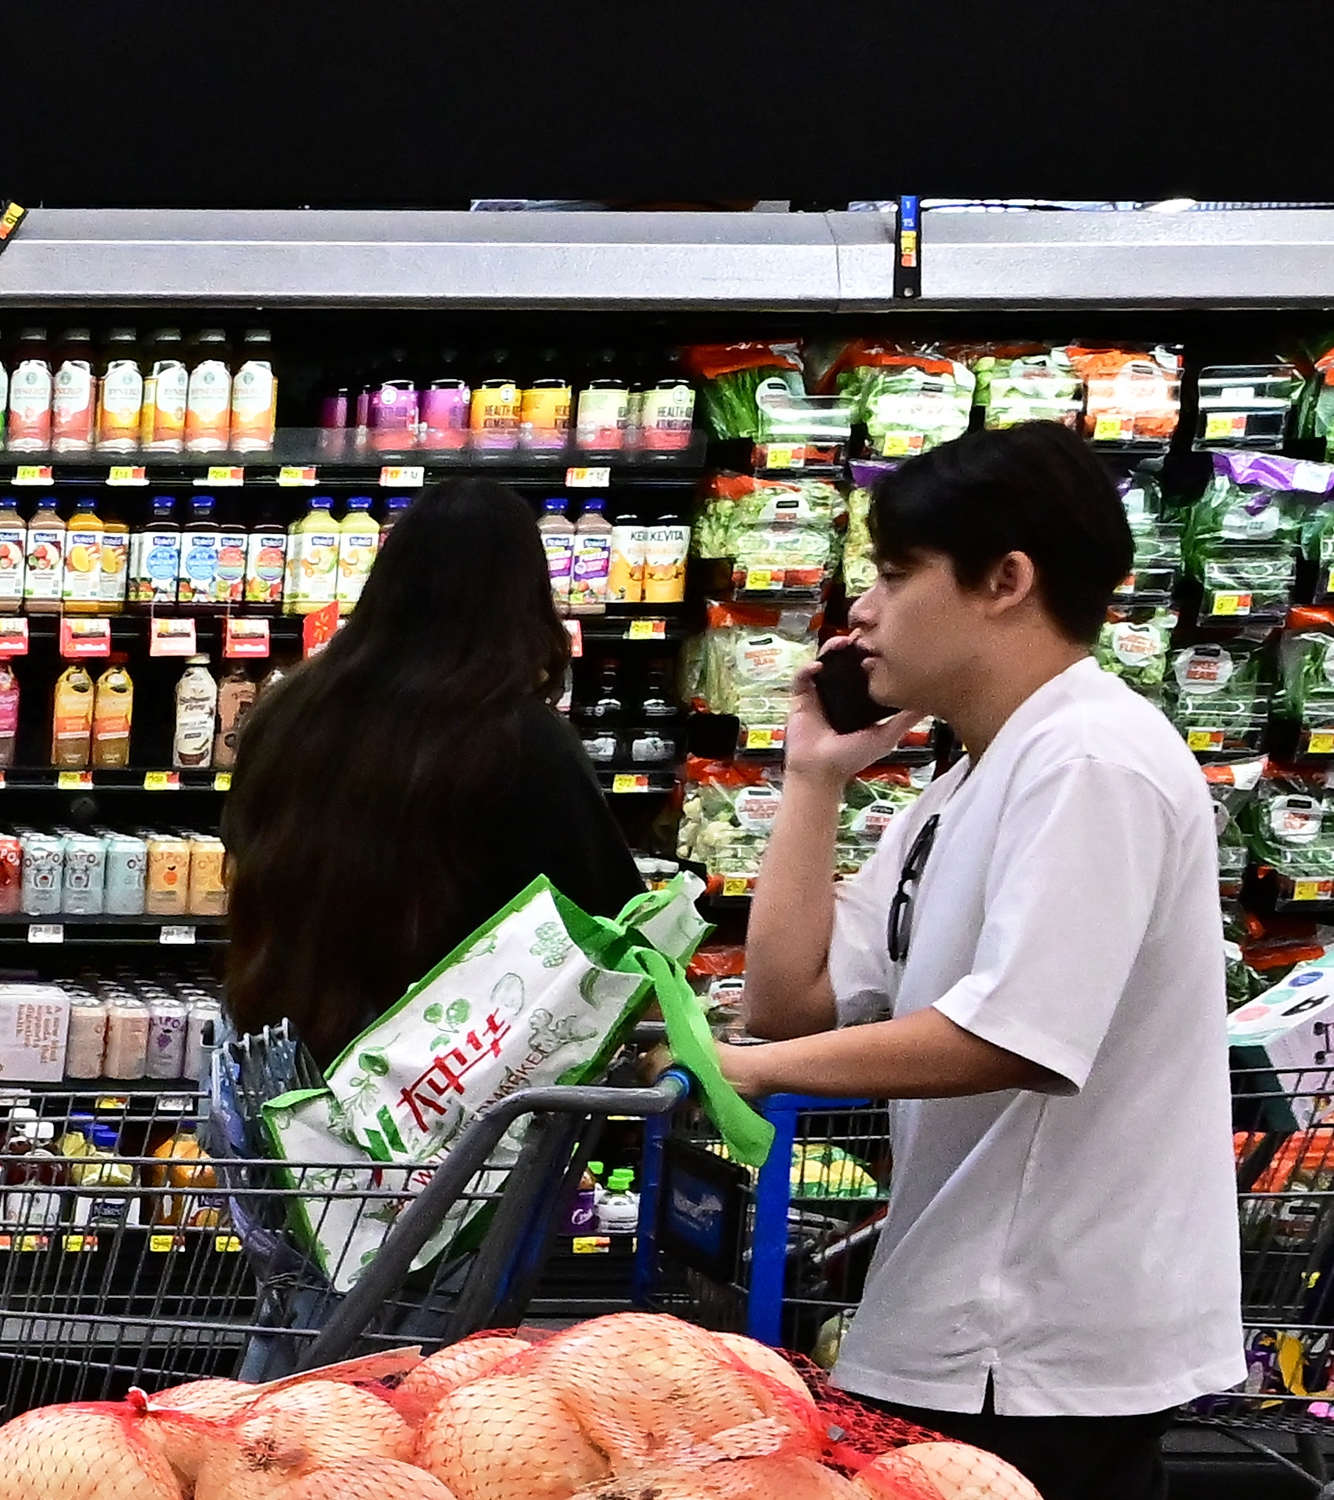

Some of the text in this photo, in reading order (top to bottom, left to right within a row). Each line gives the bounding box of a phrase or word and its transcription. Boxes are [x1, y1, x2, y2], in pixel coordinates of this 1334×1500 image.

[650, 530, 685, 542] KEVITA
[24, 852, 62, 867] OLIPO
[150, 1016, 182, 1030] LIPO
